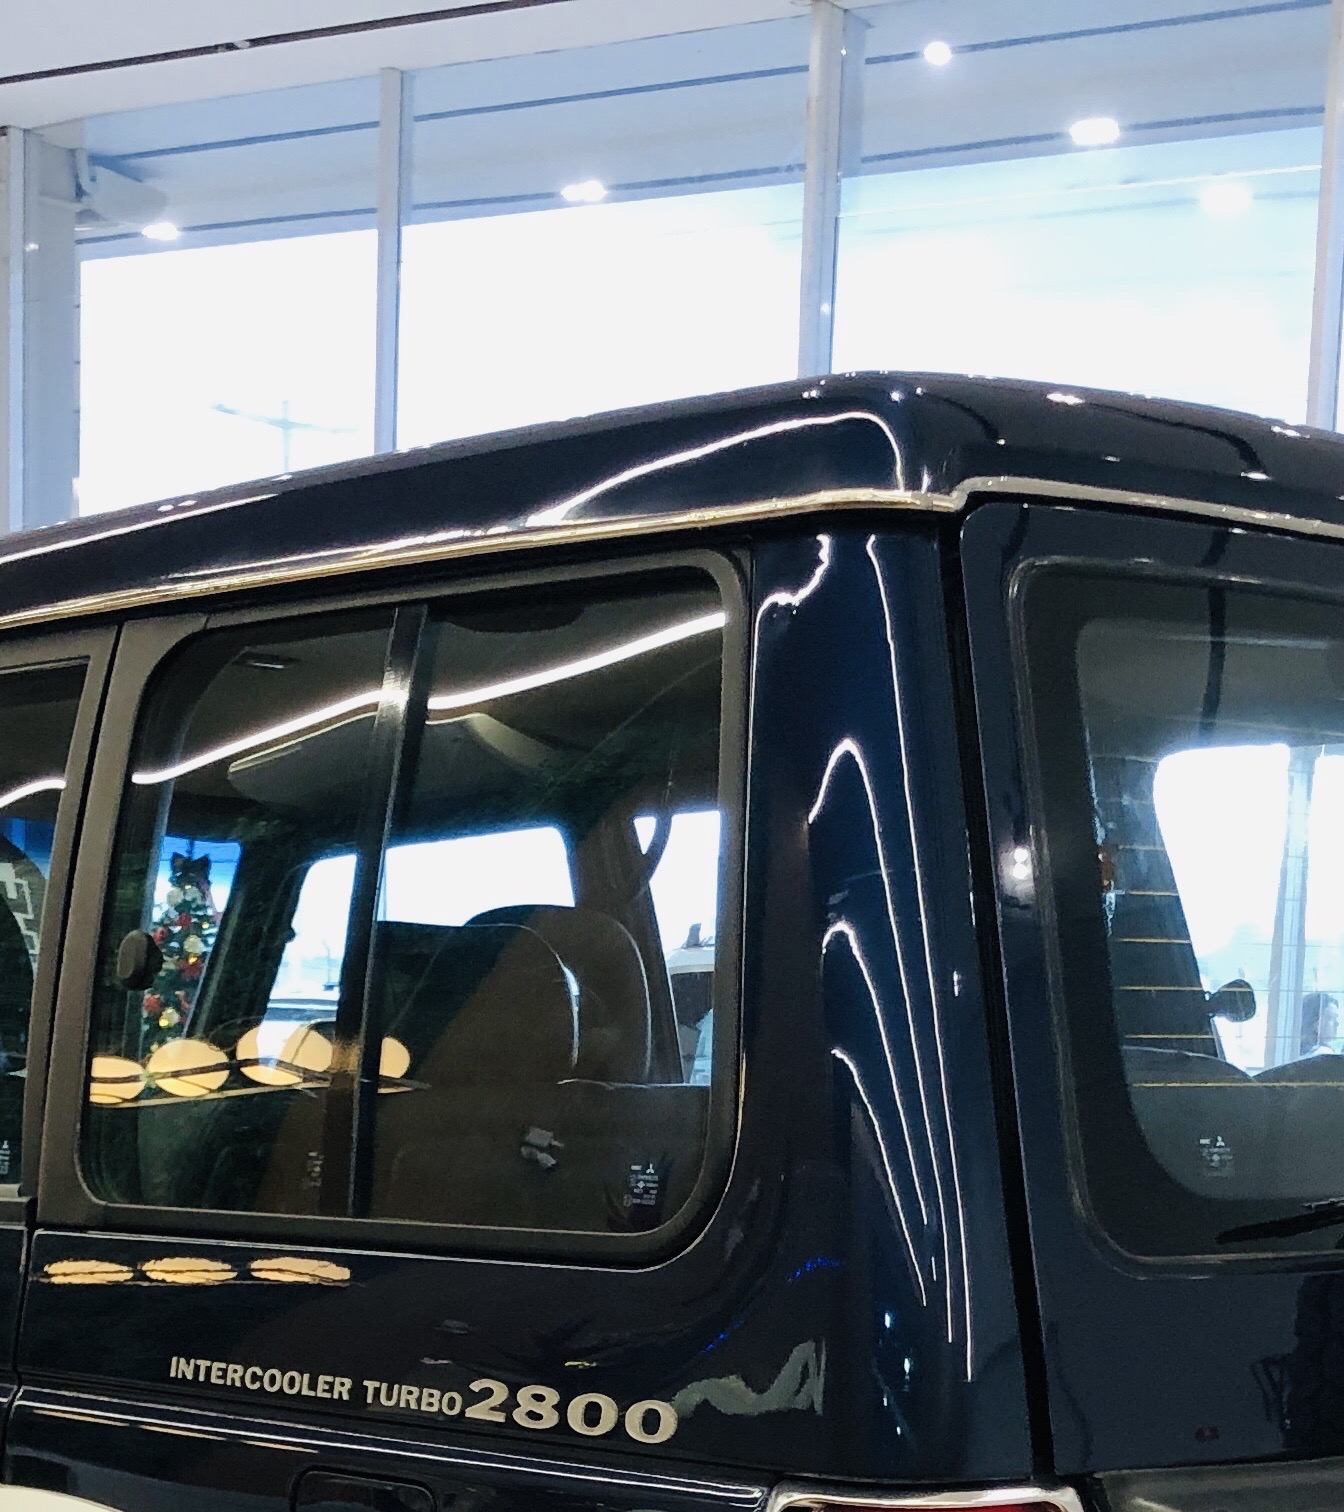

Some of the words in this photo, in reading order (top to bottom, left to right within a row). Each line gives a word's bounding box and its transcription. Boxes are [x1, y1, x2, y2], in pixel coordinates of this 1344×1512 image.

[170, 1356, 351, 1400] INTERCOOLER
[363, 1380, 462, 1415] TURBO
[465, 1378, 678, 1444] 2800
